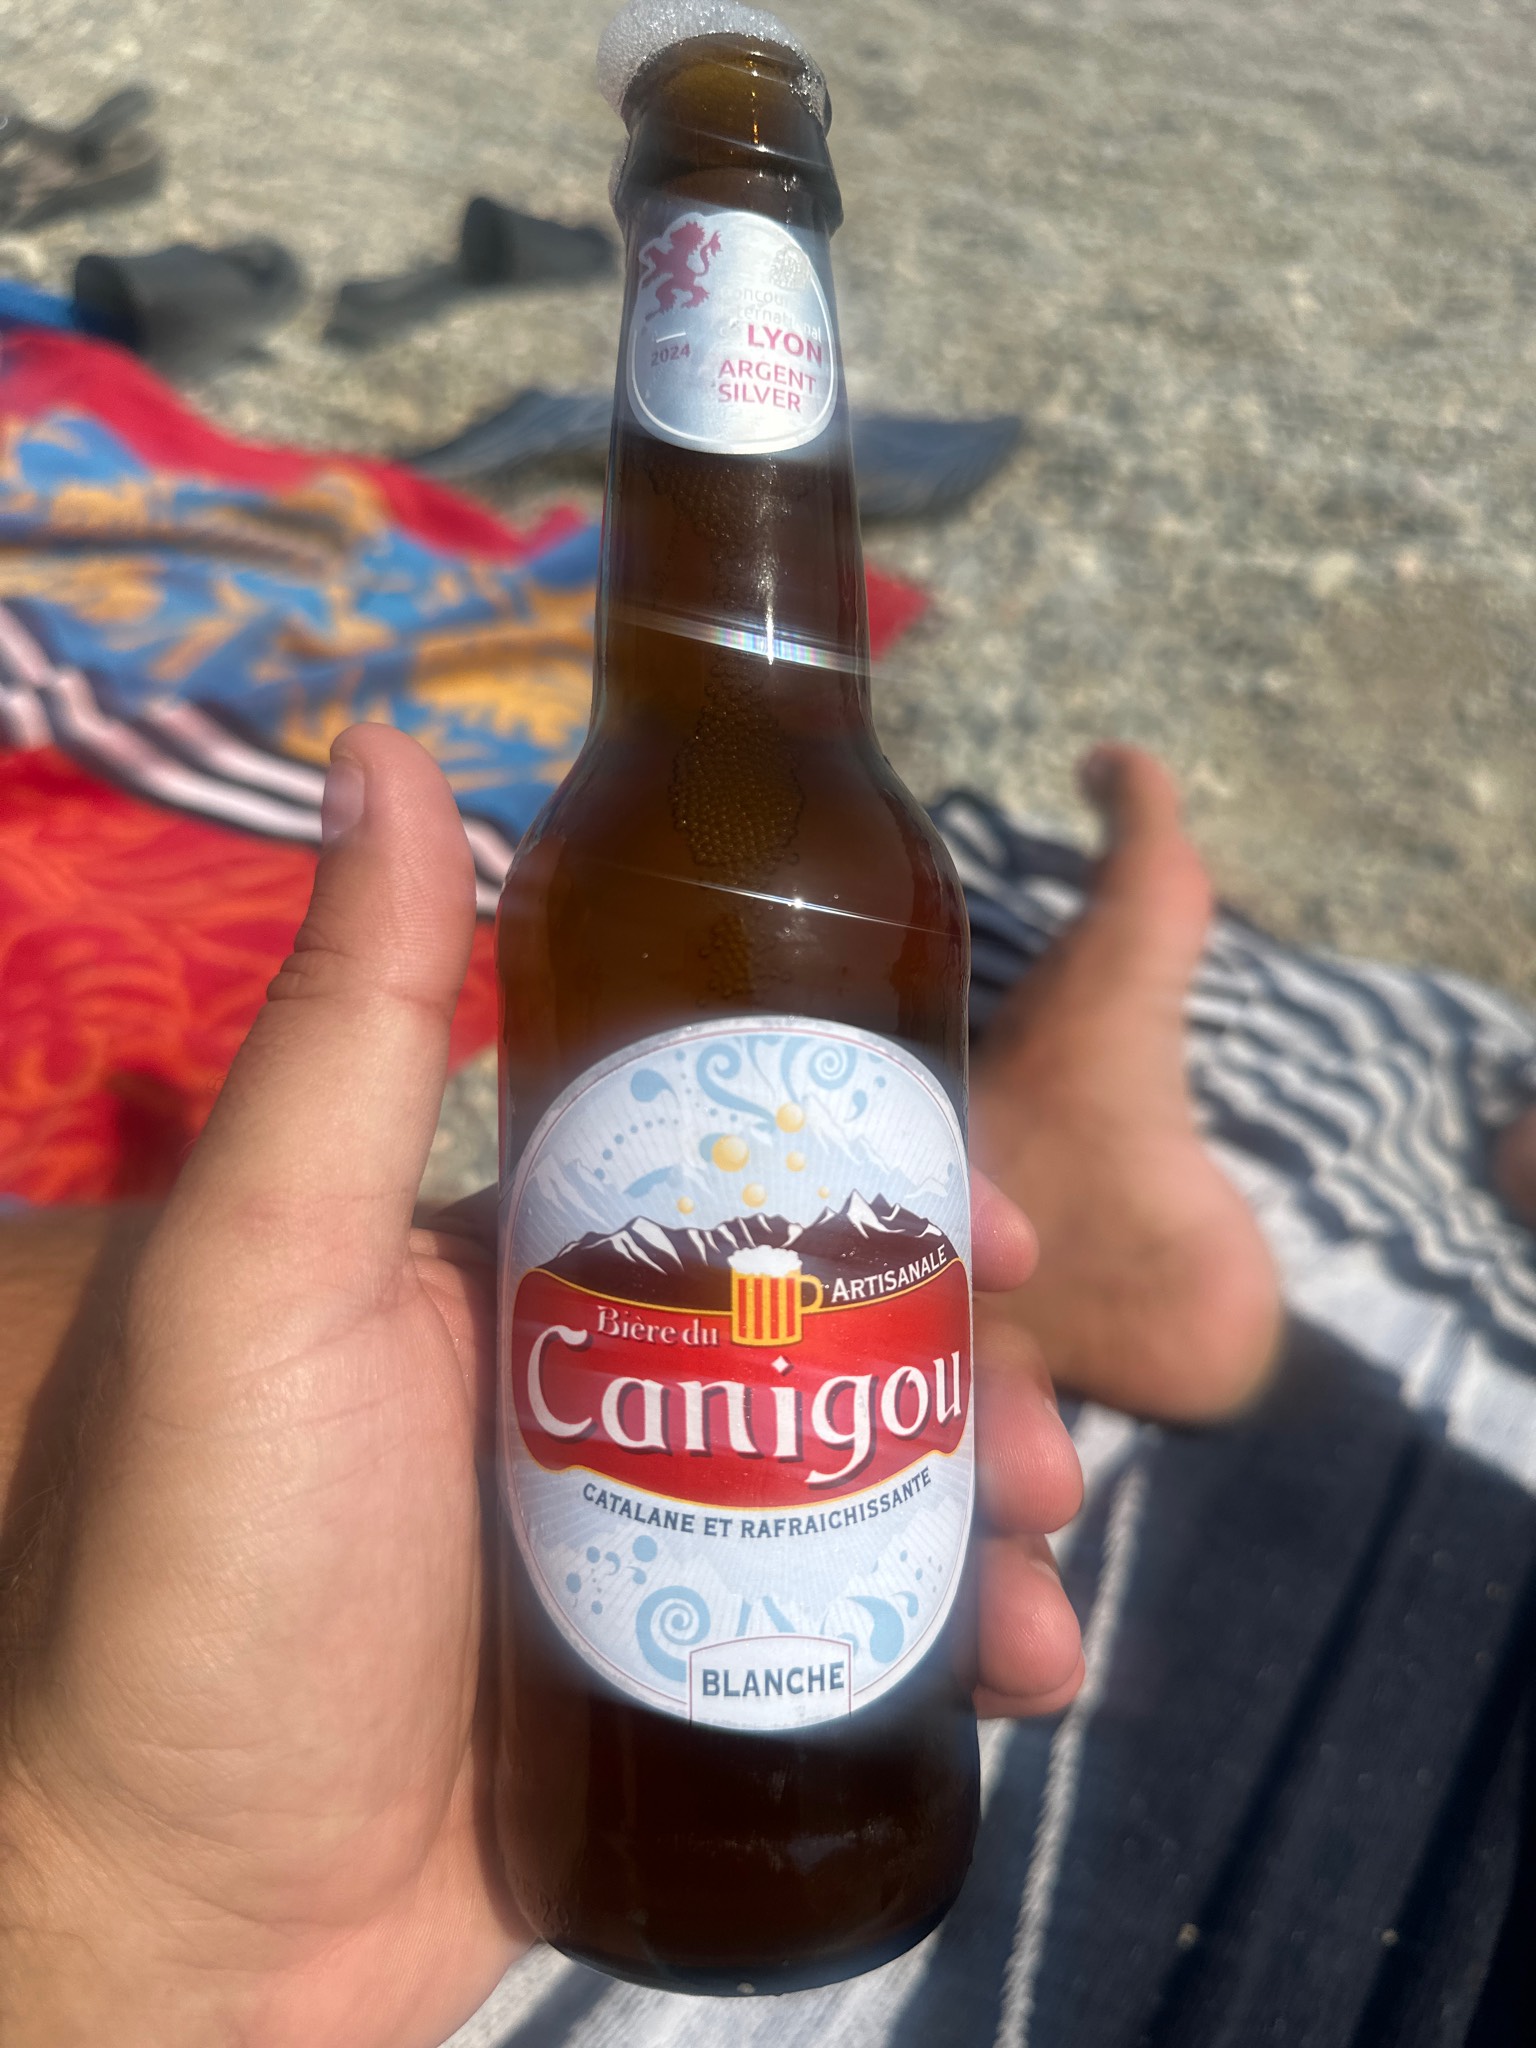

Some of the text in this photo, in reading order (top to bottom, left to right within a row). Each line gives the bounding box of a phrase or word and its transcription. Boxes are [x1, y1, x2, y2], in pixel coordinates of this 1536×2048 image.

[651, 343, 691, 367] 2024
[747, 325, 823, 368] LYON
[718, 359, 817, 395] ARGENT
[718, 383, 801, 413] SILVER
[831, 1243, 947, 1303] ARTISANALE
[597, 1305, 719, 1346] Bière du
[527, 1325, 963, 1487] Canigou
[583, 1467, 932, 1538] CATALANE ET RAFRAICHISSANTE
[702, 1661, 845, 1697] BLANCHE
